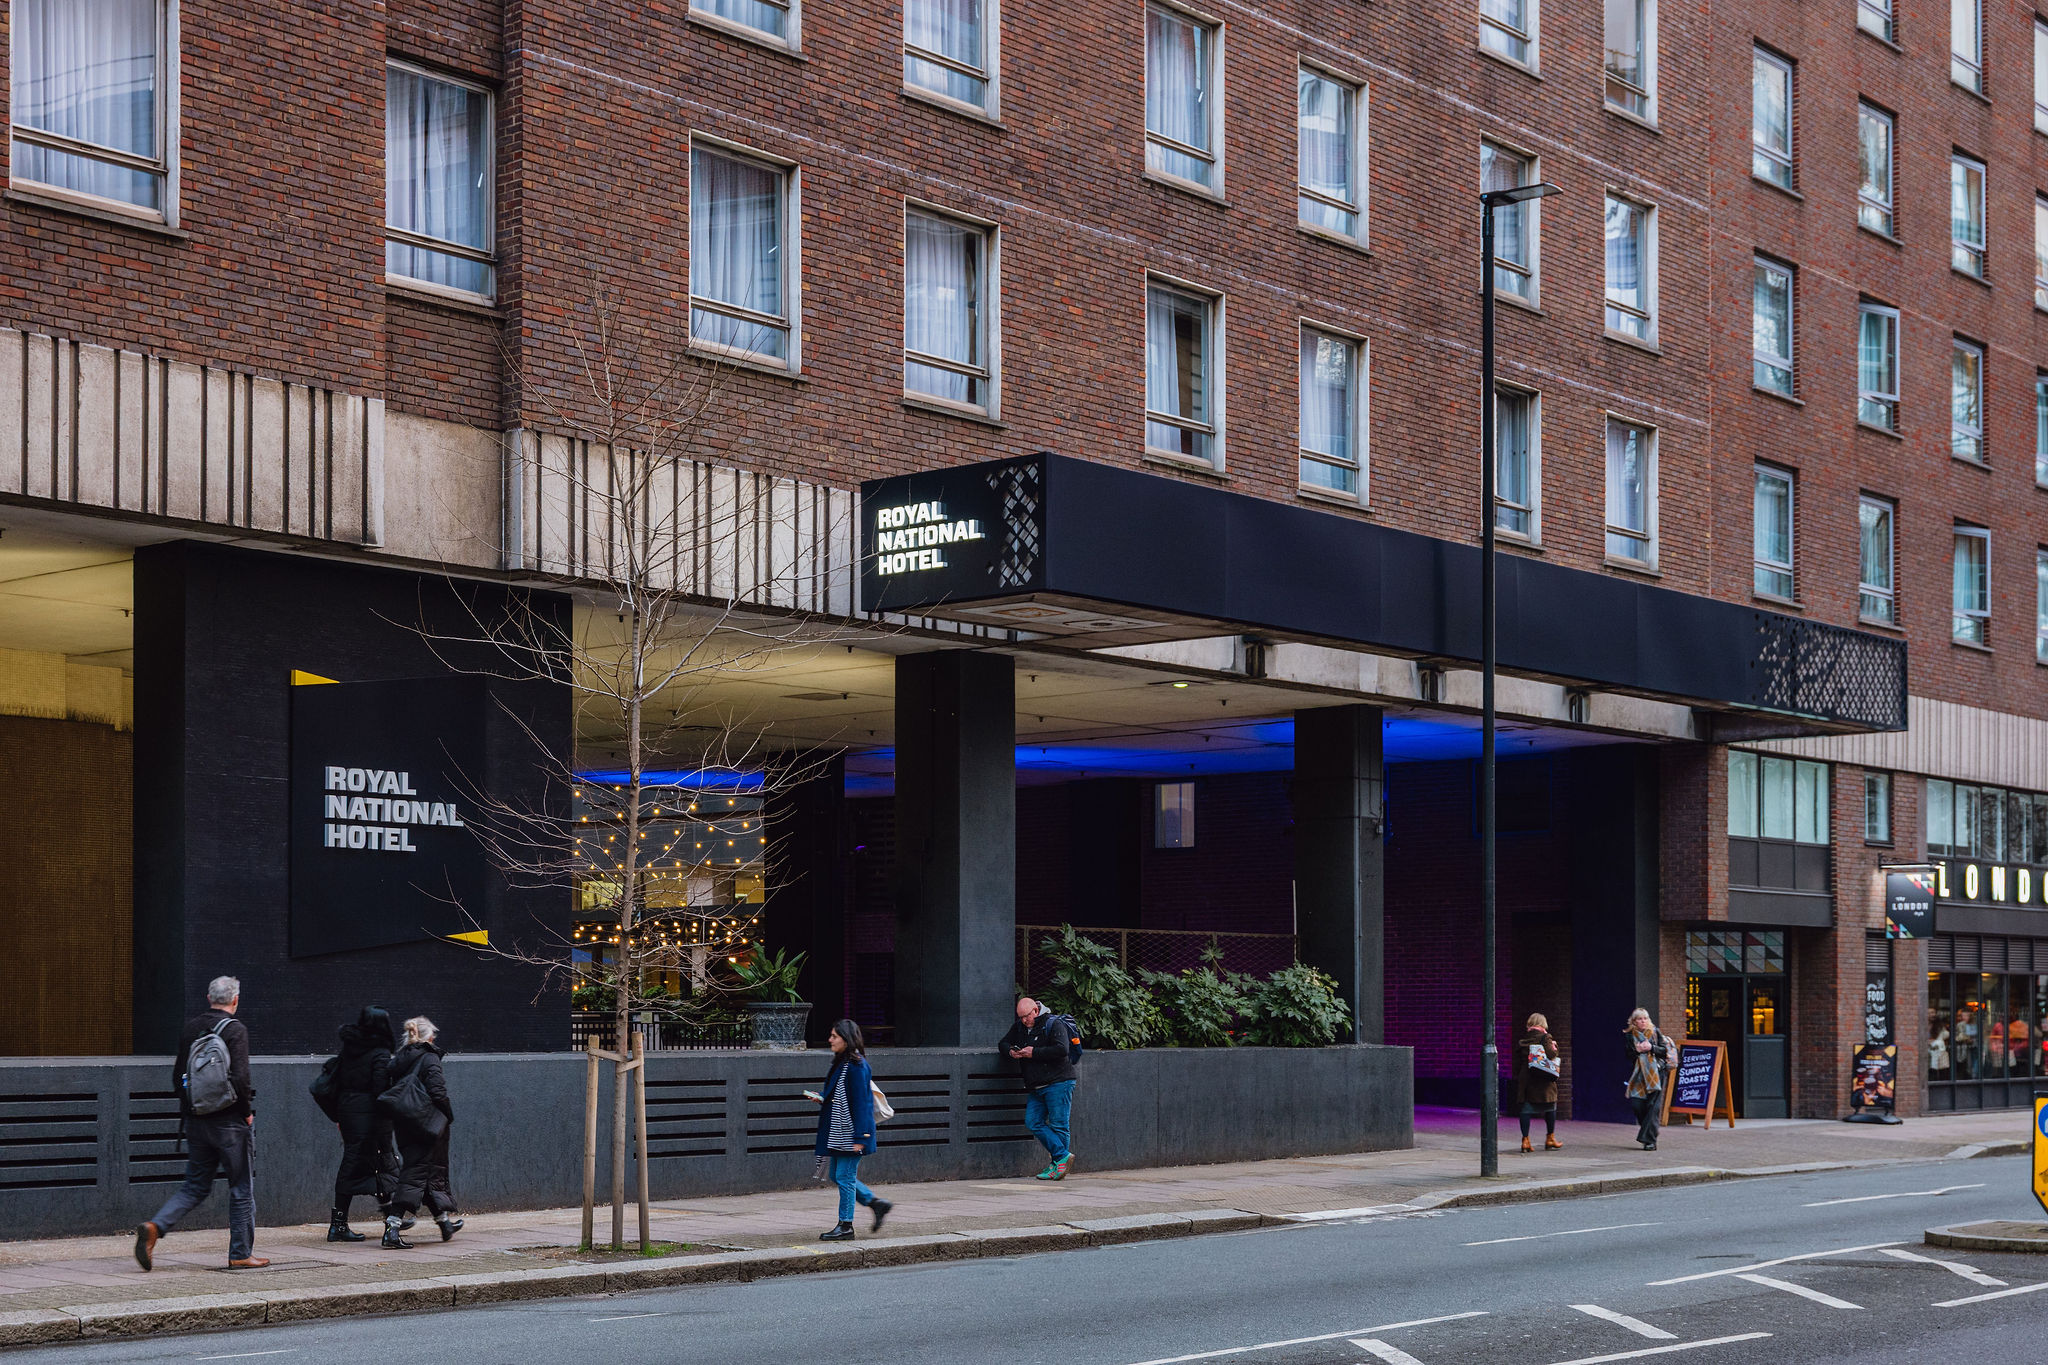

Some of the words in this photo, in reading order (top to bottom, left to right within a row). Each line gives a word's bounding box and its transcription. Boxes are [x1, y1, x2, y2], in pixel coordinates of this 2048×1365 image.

[878, 501, 947, 530] ROYAL
[878, 519, 985, 552] NATIONAL
[878, 548, 948, 576] HOTEL
[325, 766, 417, 796] ROYAL
[324, 794, 464, 827] NATIONAL
[324, 823, 417, 852] HOTEL
[1891, 902, 1929, 911] LONDON
[1867, 990, 1885, 1001] FOOD
[1679, 1065, 1711, 1076] SUNDAY
[1683, 1053, 1711, 1062] SERVING
[1679, 1074, 1709, 1085] ROASTS
